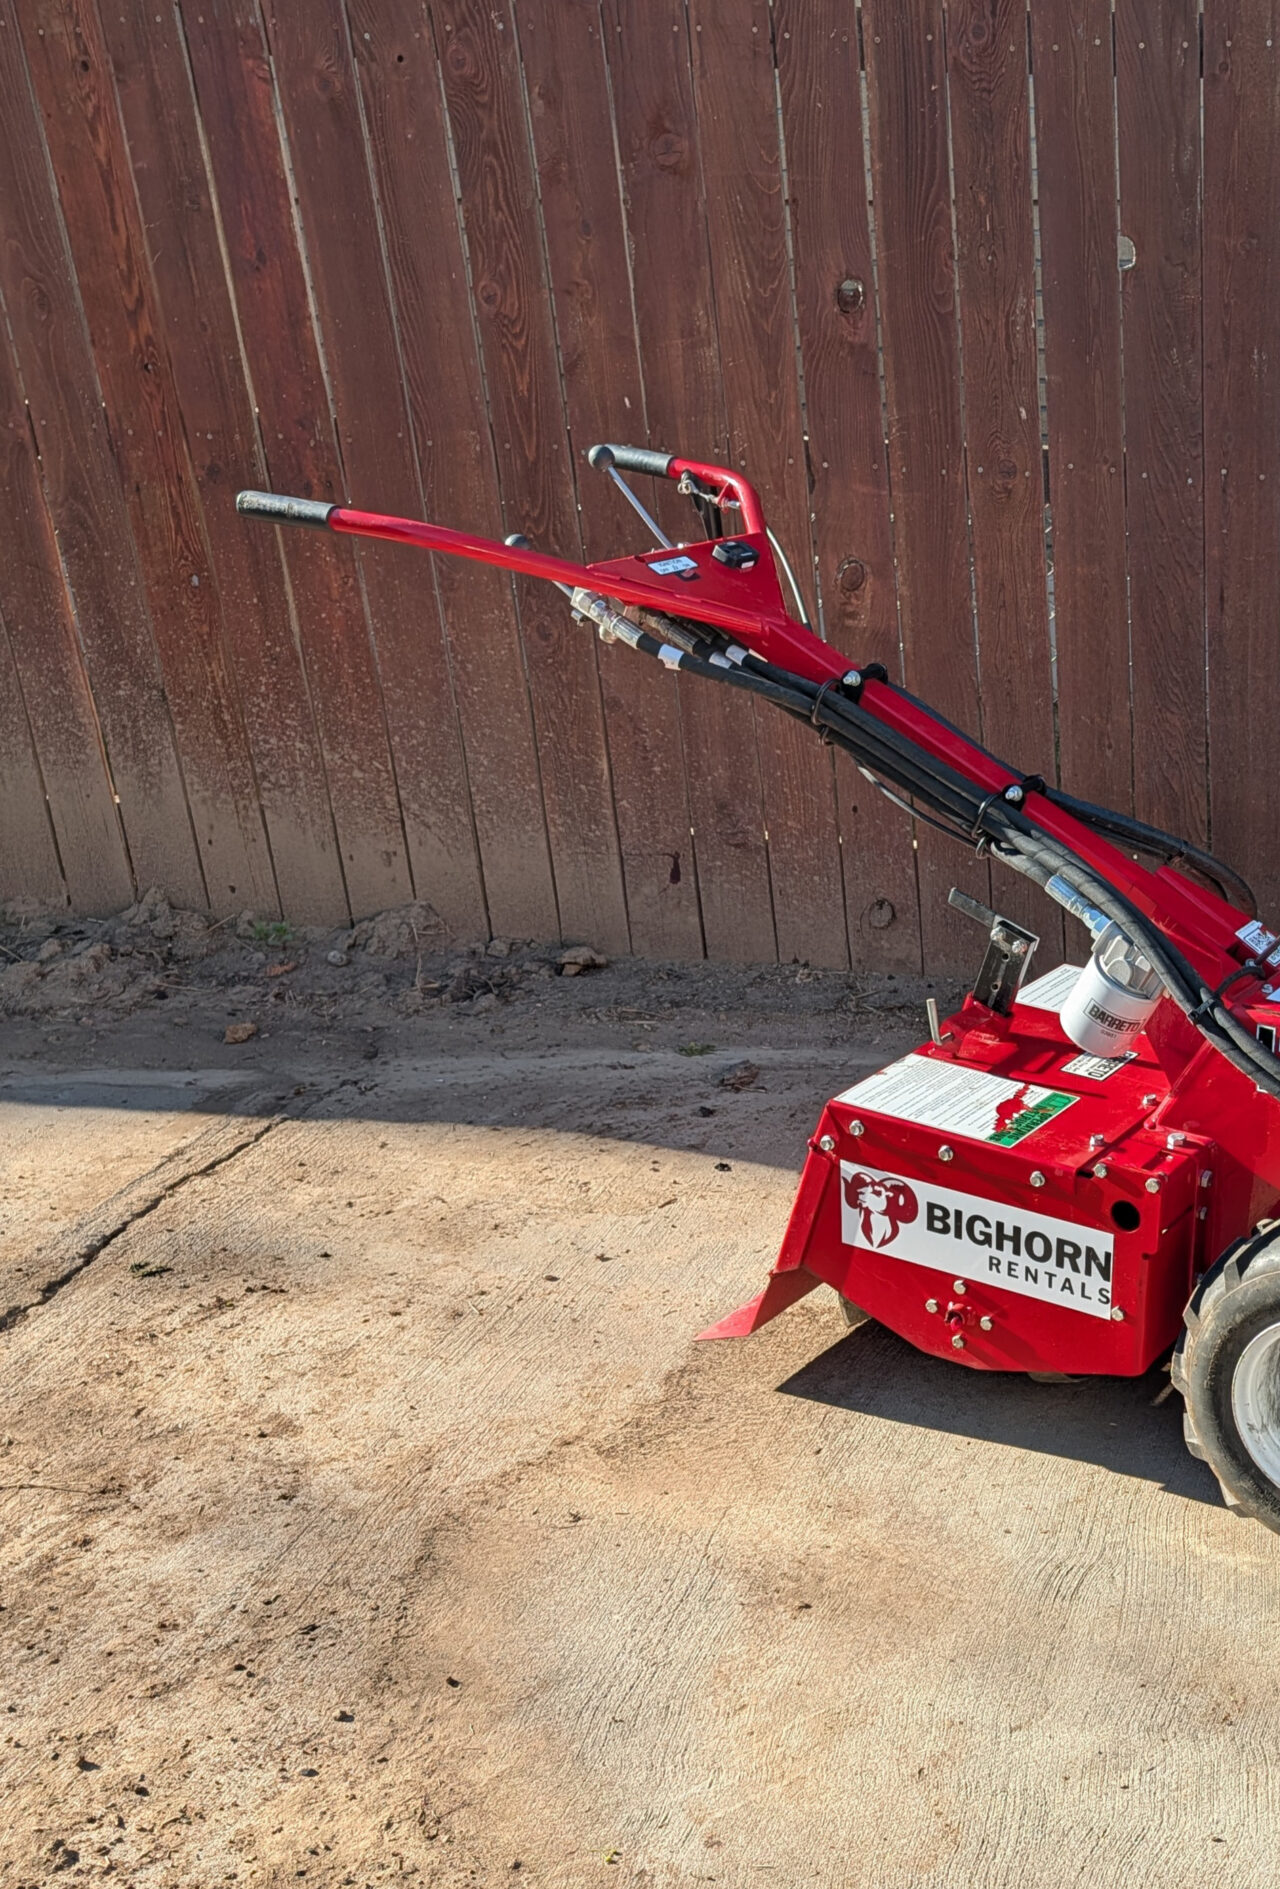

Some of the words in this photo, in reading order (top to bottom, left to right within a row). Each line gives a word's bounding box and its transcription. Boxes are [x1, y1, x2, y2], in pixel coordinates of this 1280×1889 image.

[1089, 1003, 1140, 1032] BARRETO
[926, 1201, 1112, 1283] BIGHORN
[988, 1255, 1111, 1305] RENTALS
